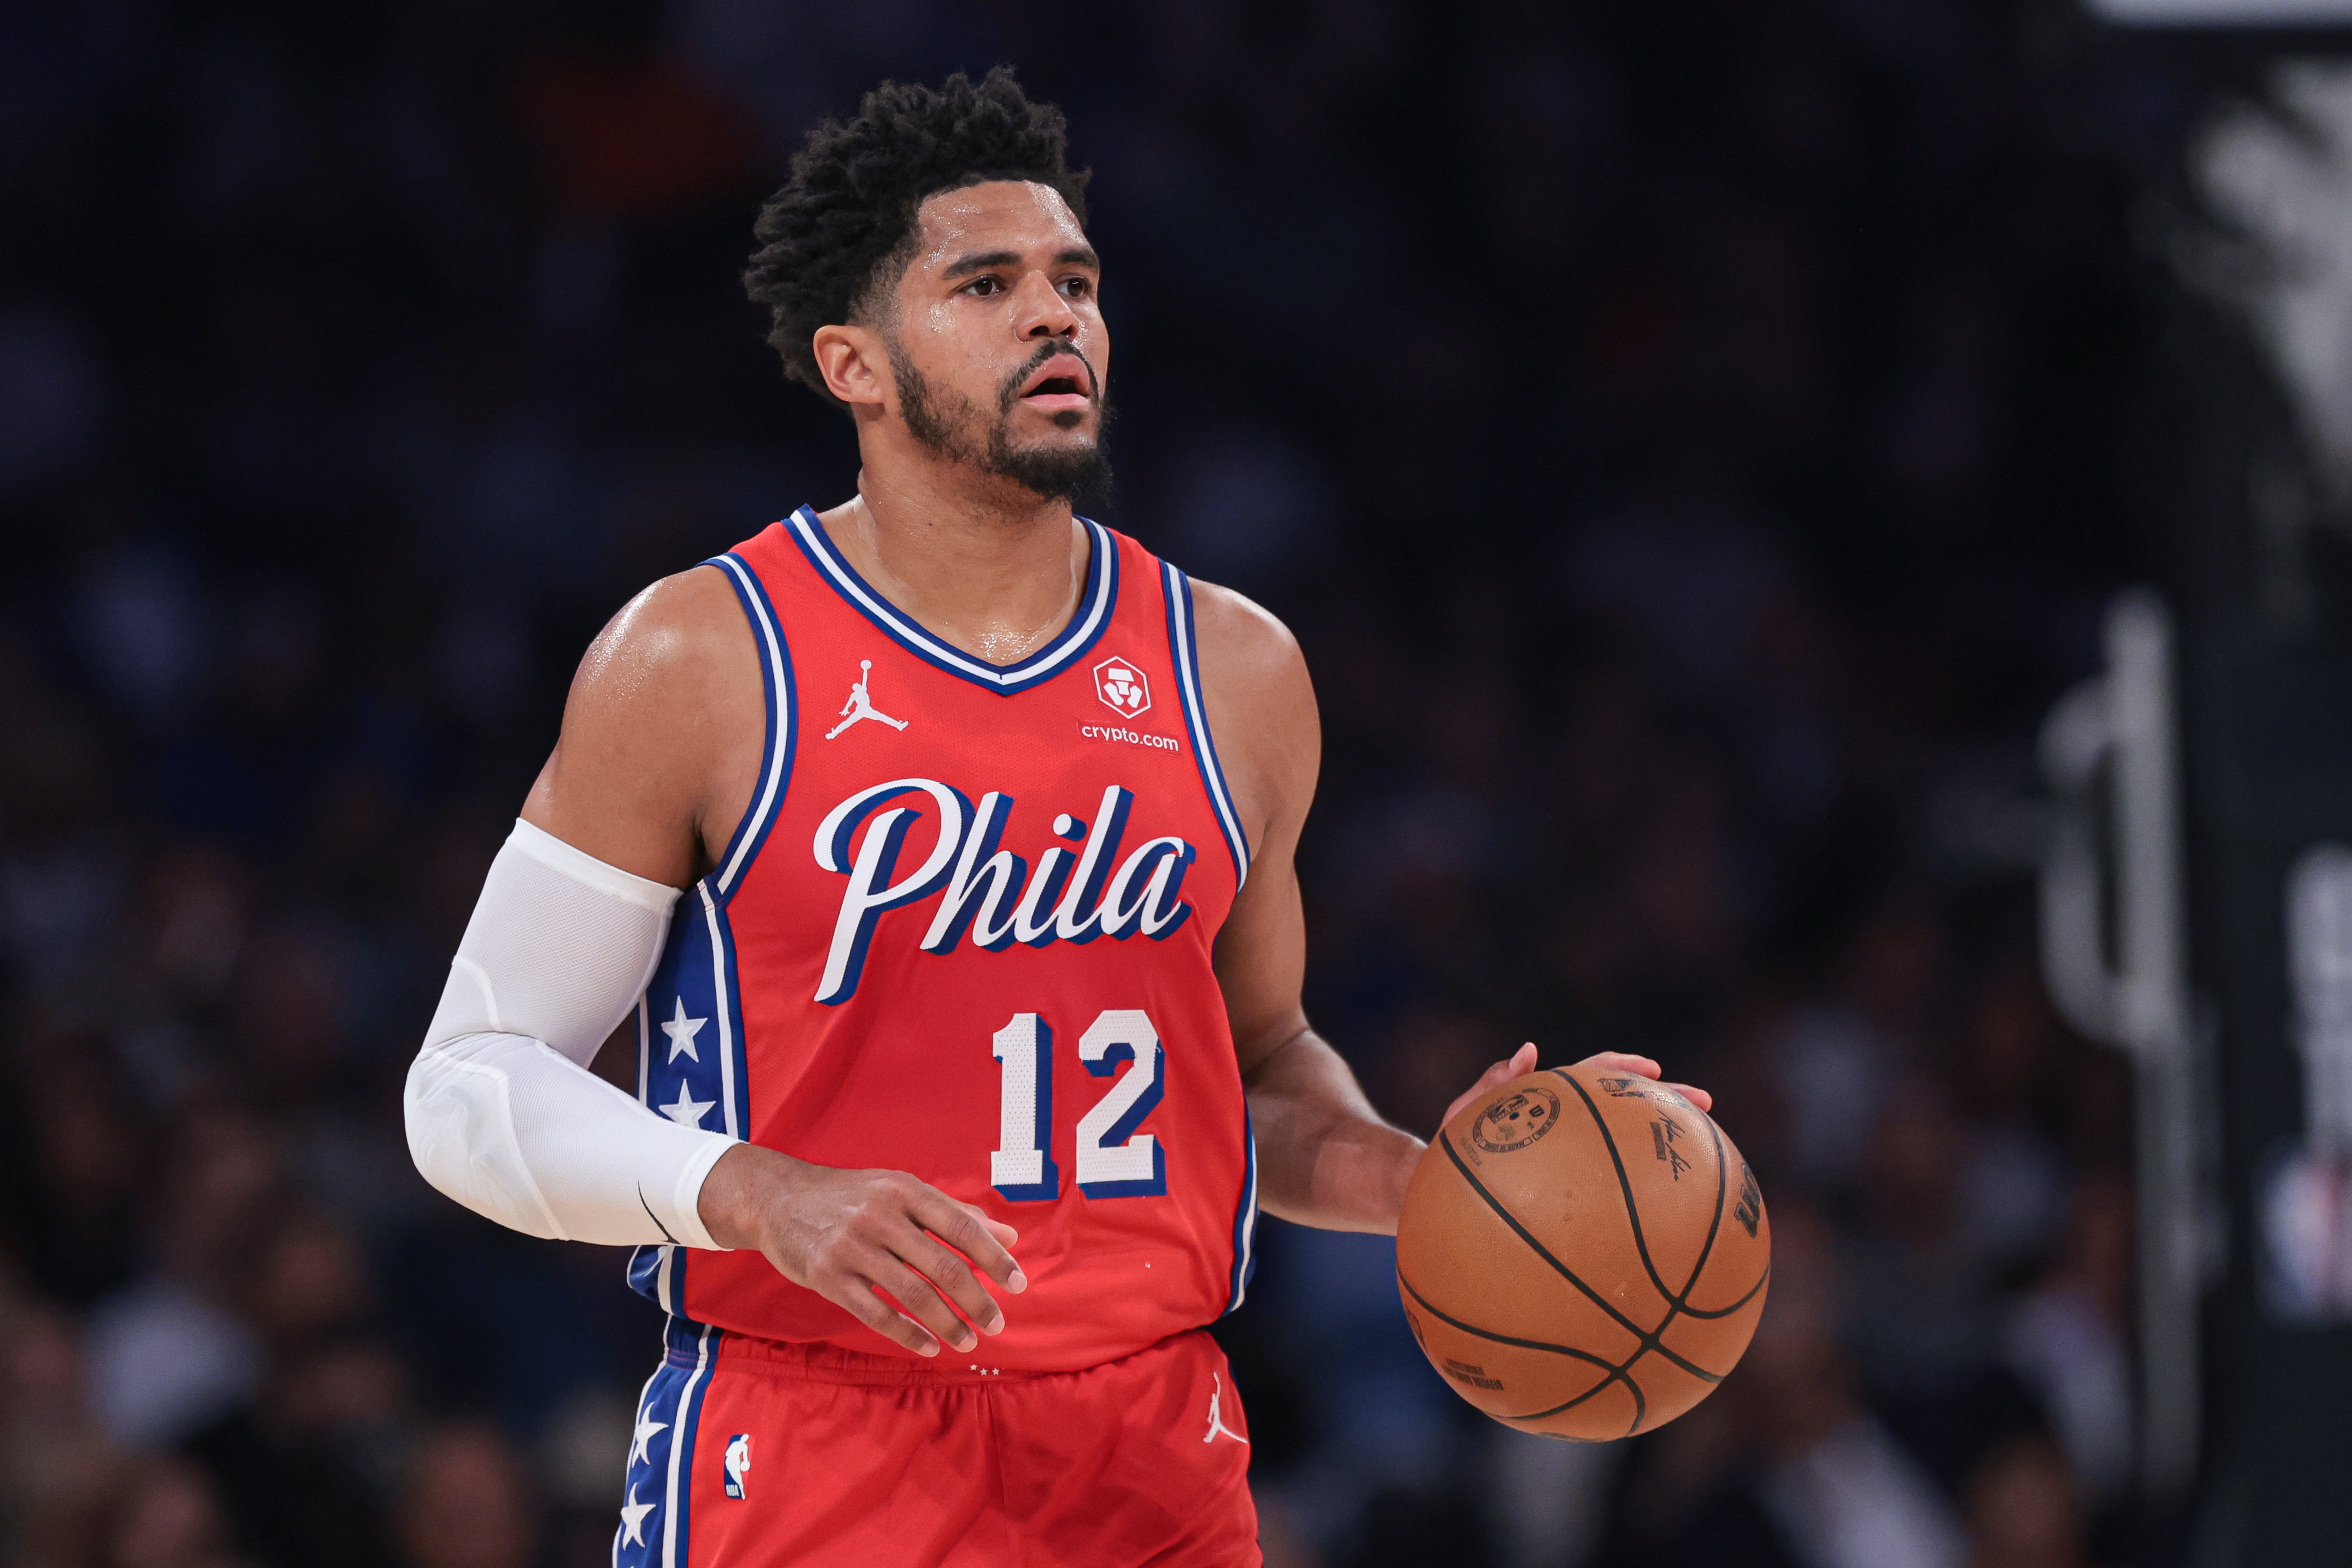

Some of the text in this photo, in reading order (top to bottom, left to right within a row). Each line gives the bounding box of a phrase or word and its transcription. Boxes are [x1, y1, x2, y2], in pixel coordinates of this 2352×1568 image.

[1082, 725, 1179, 751] crypto.com
[813, 778, 1195, 1006] Phila
[990, 1009, 1168, 1201] 12
[726, 1485, 739, 1496] NBA
